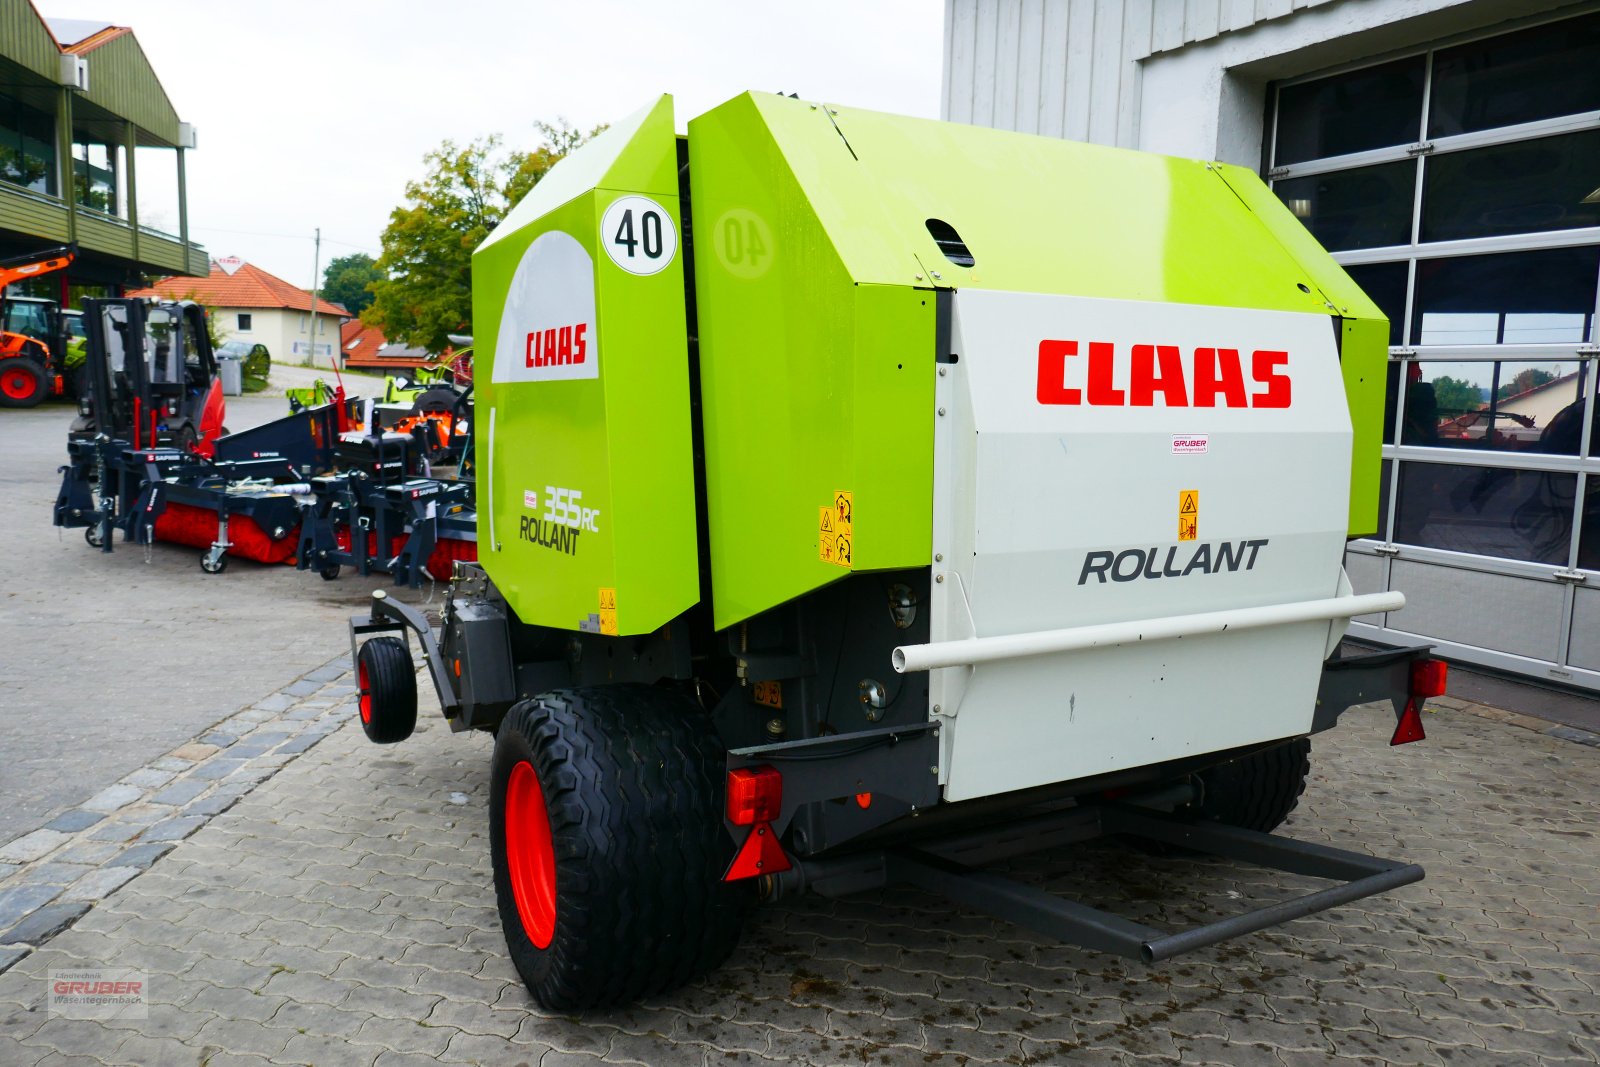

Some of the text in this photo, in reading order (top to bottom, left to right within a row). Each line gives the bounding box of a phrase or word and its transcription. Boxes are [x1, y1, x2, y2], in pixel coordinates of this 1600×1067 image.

[614, 208, 663, 259] 40
[525, 322, 588, 368] CLAAS
[1036, 339, 1292, 409] CLAAS
[519, 515, 580, 556] ROLLANT
[1077, 538, 1269, 586] ROLLANT
